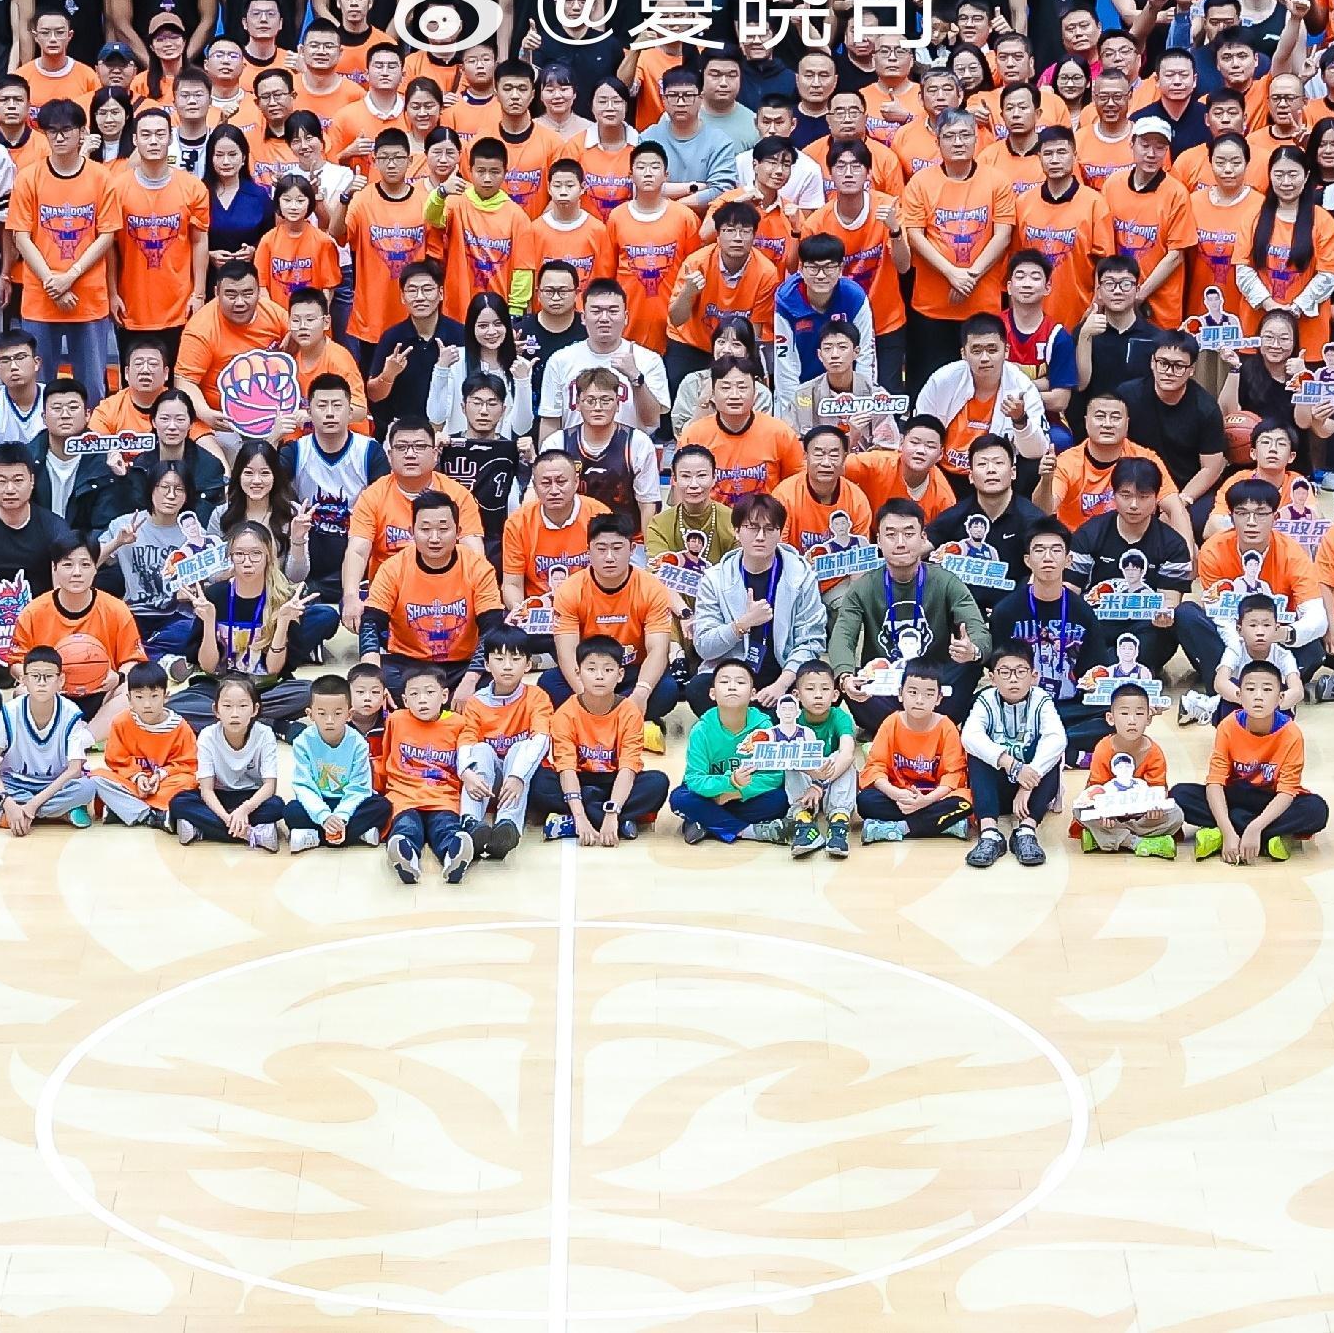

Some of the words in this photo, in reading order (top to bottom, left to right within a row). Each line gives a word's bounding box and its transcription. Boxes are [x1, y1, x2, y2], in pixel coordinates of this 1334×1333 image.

[39, 203, 95, 222] SHANDONG
[127, 213, 180, 231] SHANDONG
[936, 206, 988, 226] SHANDONG
[369, 224, 425, 243] SHANDONG
[1025, 225, 1076, 245] SHANDONG
[821, 396, 907, 415] SHANDONG
[67, 436, 153, 454] SHANDONG
[660, 564, 701, 588] 祝铭
[406, 599, 467, 621] SHANDONG
